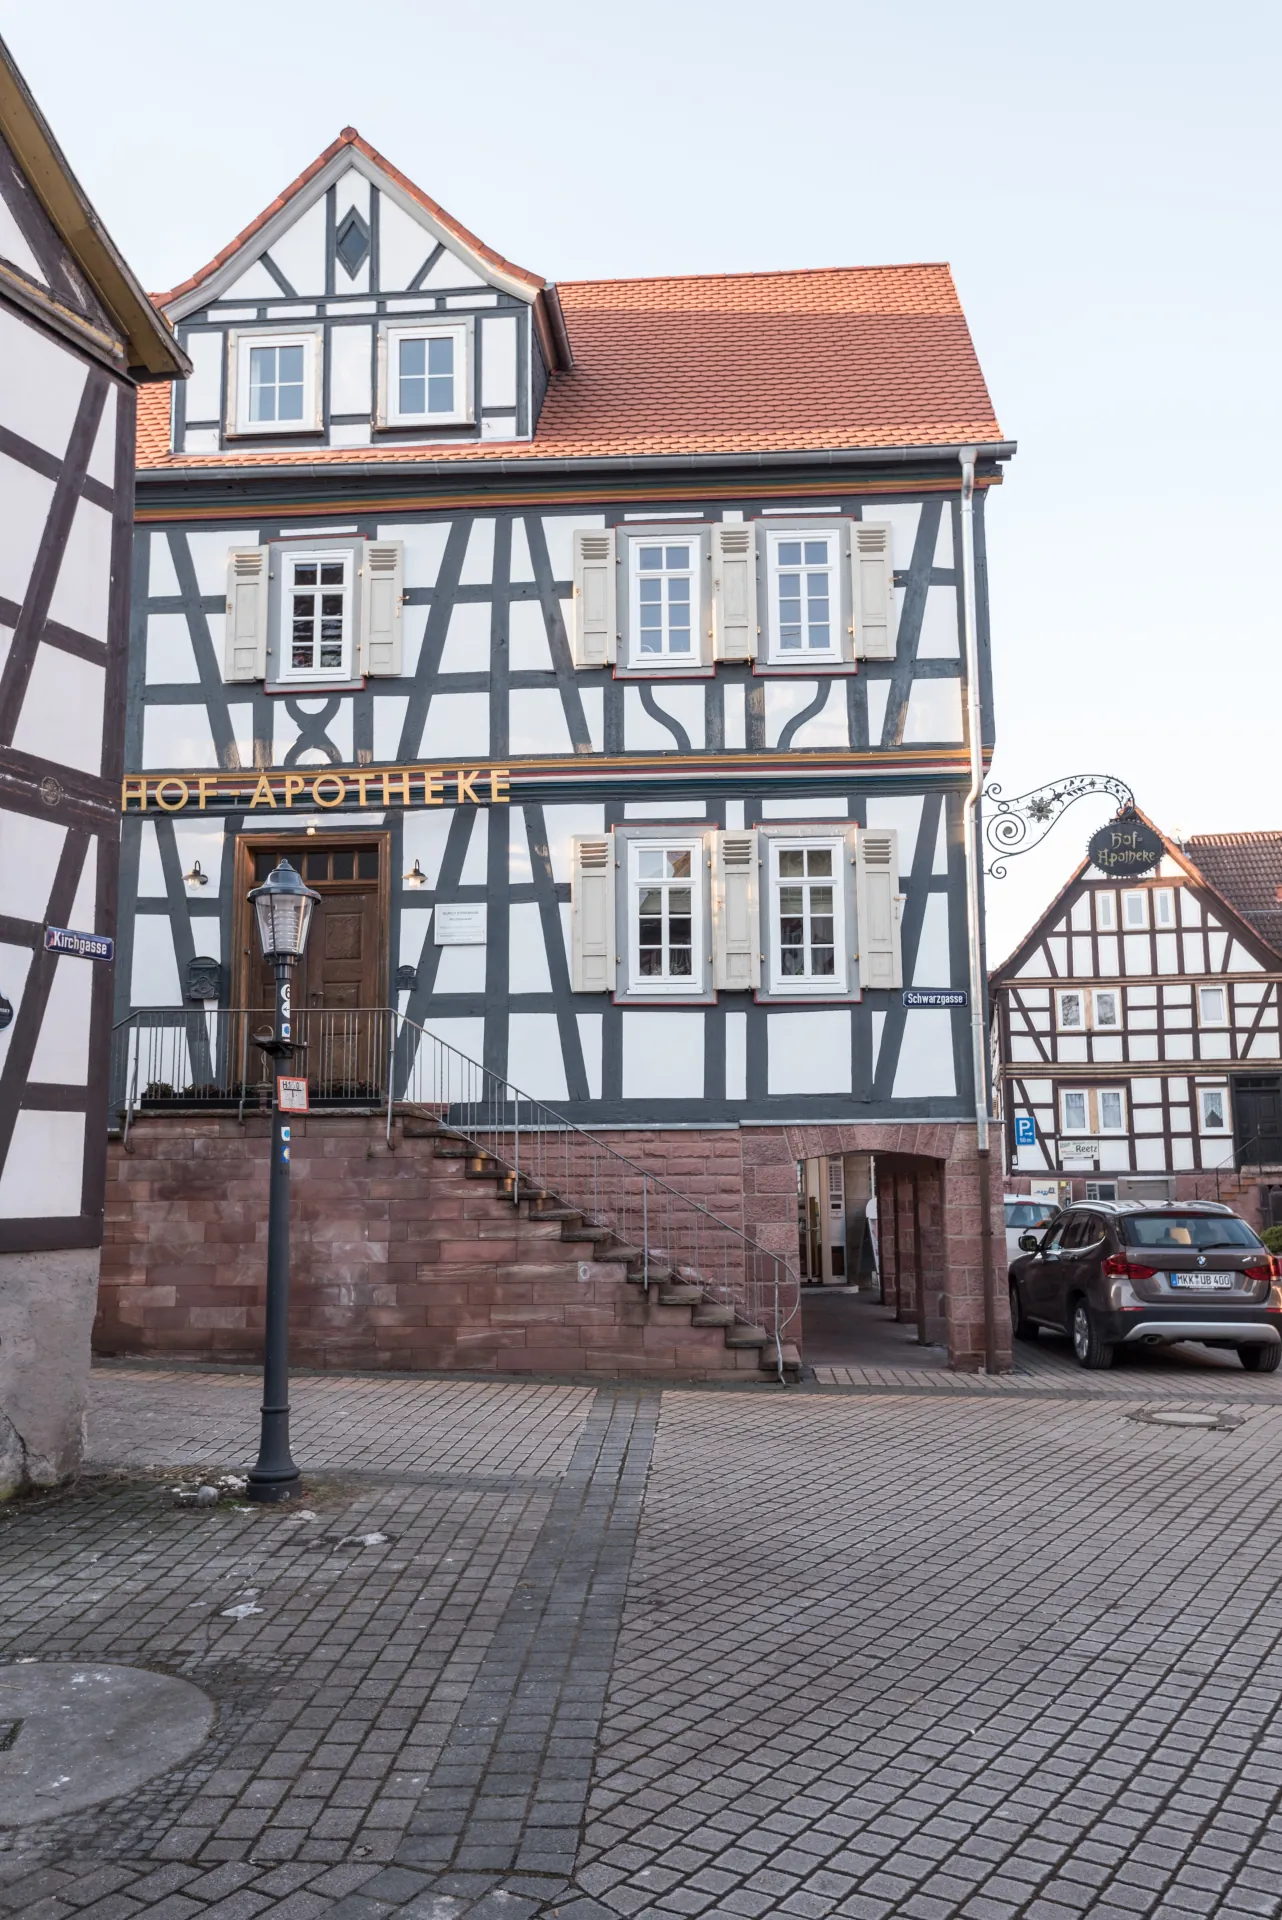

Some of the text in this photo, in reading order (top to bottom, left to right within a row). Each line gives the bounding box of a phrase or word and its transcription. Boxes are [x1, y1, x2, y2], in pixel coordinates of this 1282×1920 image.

[1111, 831, 1143, 850] Hof-
[1097, 848, 1156, 867] Apotheke
[53, 931, 107, 955] Kirchgasse
[907, 993, 963, 1006] Schwarzgasse
[1019, 1120, 1031, 1137] P
[1075, 1144, 1098, 1153] Reetz
[1177, 1275, 1230, 1285] MKK UB 400
